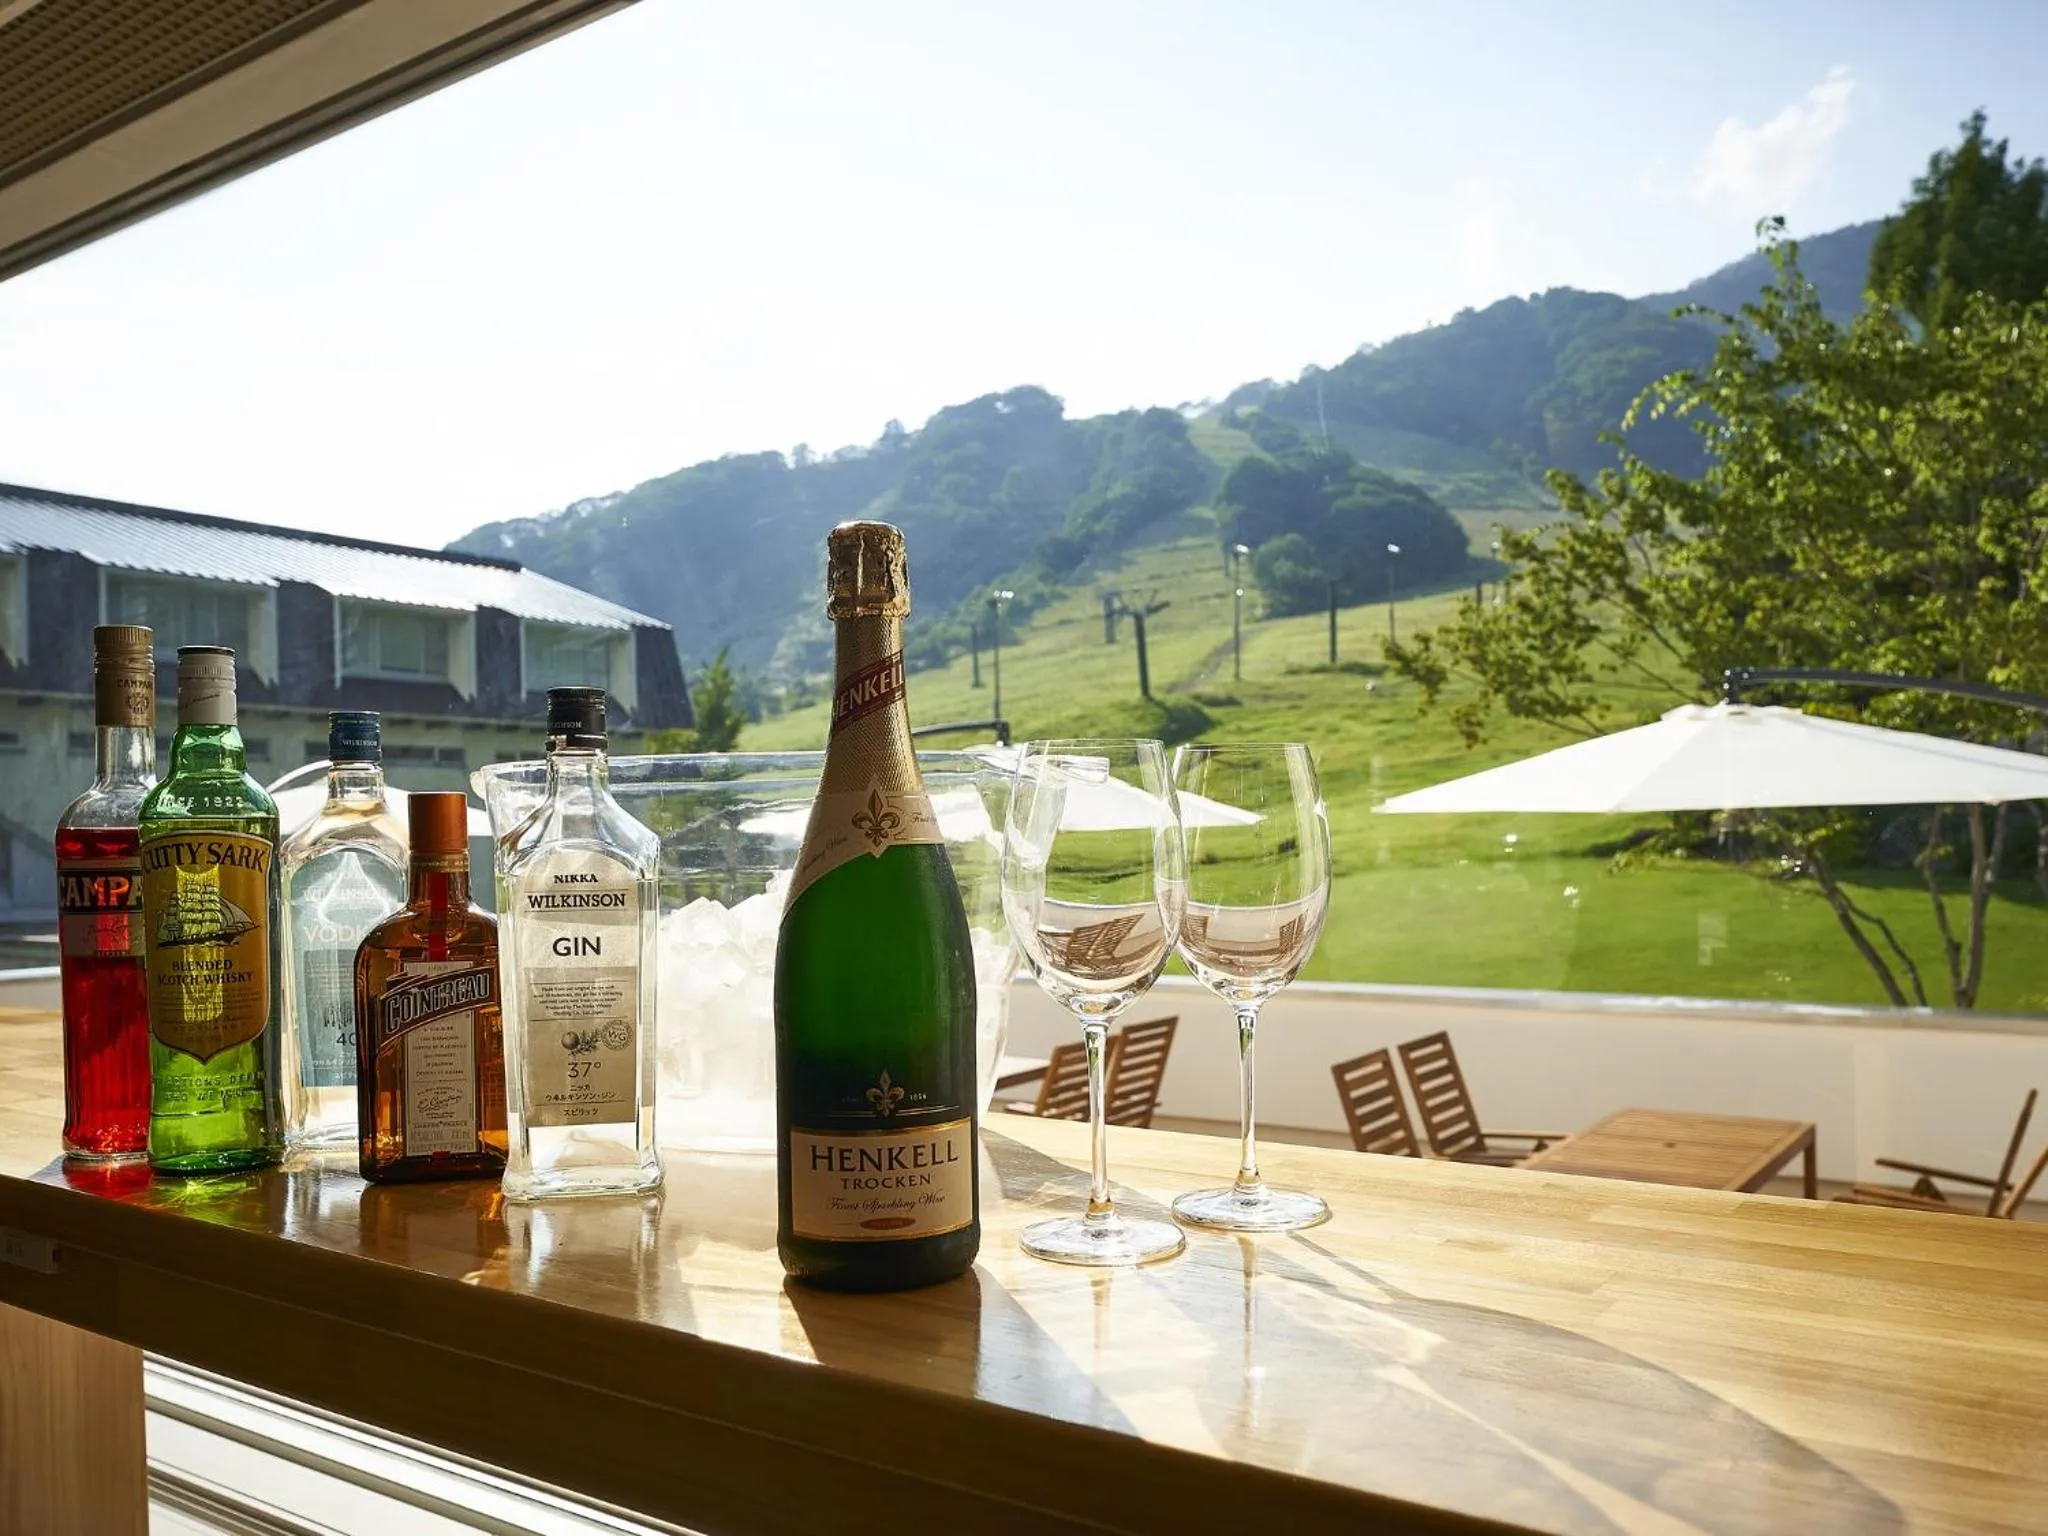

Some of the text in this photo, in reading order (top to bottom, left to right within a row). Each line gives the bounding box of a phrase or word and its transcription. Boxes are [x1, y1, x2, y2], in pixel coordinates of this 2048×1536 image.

[838, 659, 905, 718] ENKELL
[206, 842, 268, 873] SARK
[553, 873, 599, 884] NIKKA
[527, 893, 627, 909] WILKINSON
[552, 936, 601, 957] GIN
[172, 959, 234, 972] BLENDED
[203, 971, 254, 985] WHISKY
[385, 972, 491, 1035] COINTREAU
[567, 1061, 602, 1078] 37°
[811, 1140, 959, 1172] HENKELL
[841, 1173, 932, 1190] TROCKEN
